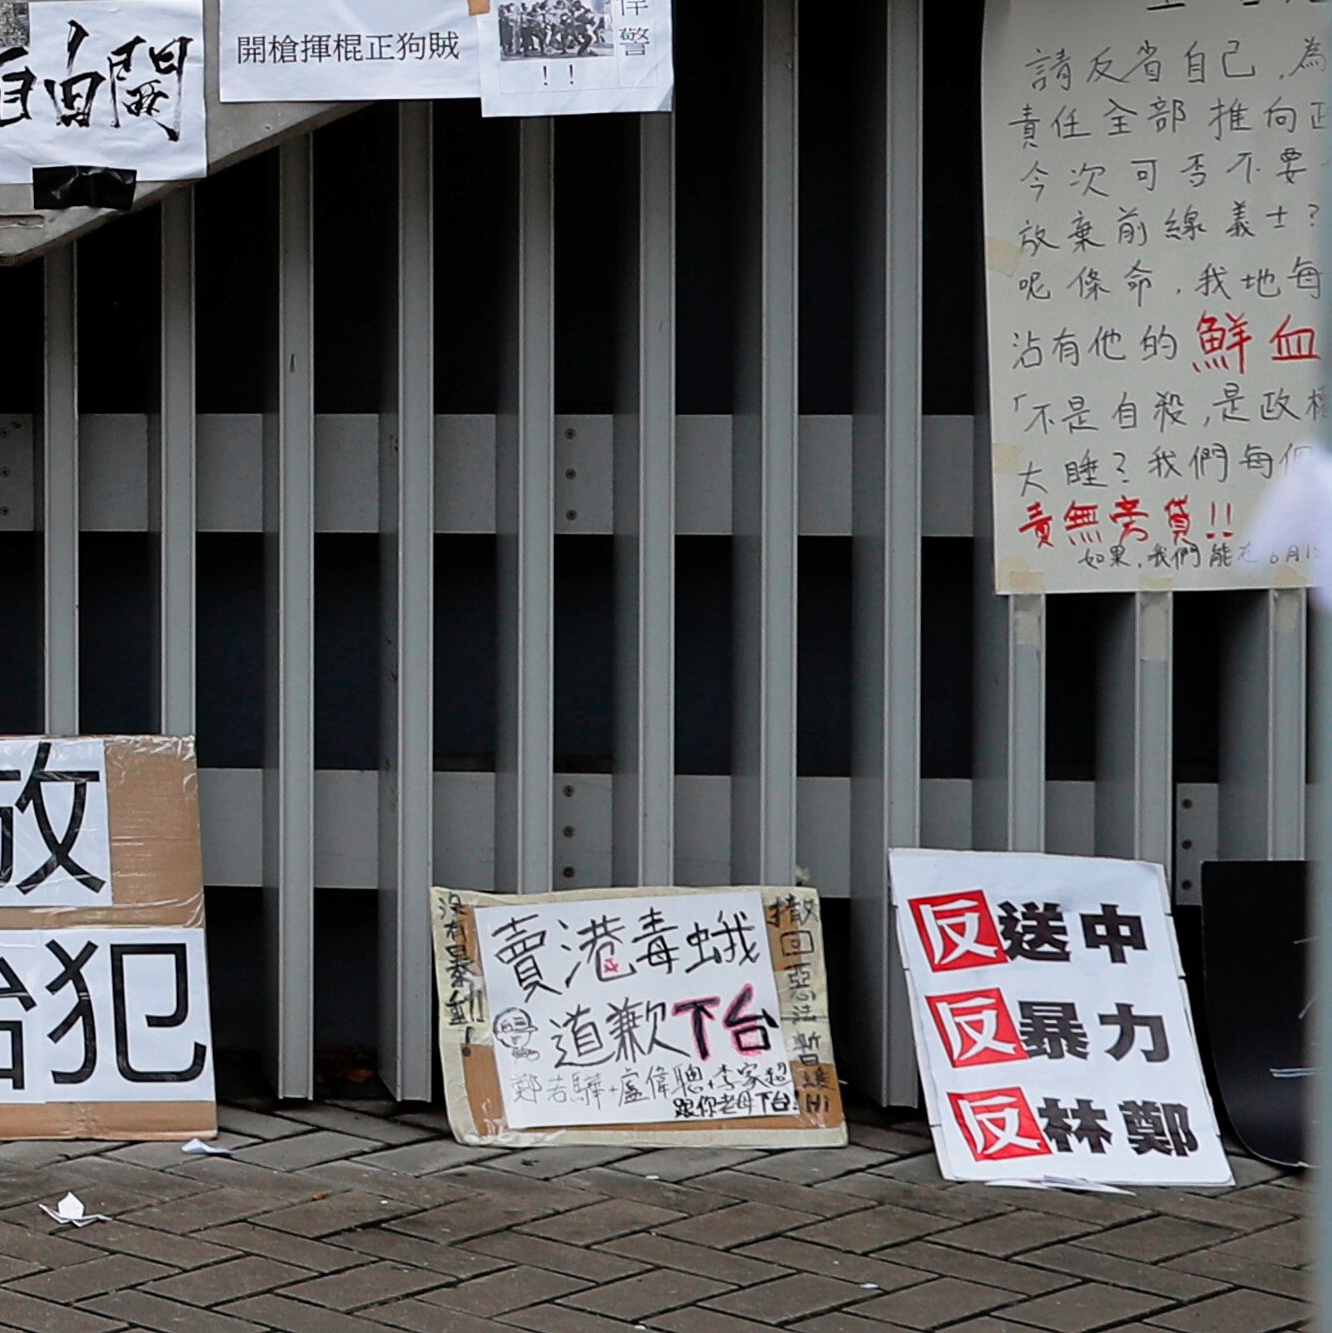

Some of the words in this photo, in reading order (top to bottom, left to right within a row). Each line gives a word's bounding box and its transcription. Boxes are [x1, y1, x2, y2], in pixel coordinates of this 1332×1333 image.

[236, 32, 460, 65] 開槍揮棍正狗賊
[491, 906, 763, 1003] 賣港毒蛾
[921, 897, 1148, 965] 反送中
[550, 981, 782, 1069] 道歉下台
[938, 996, 1171, 1062] 反暴力
[958, 1092, 1200, 1158] 反林鄭
